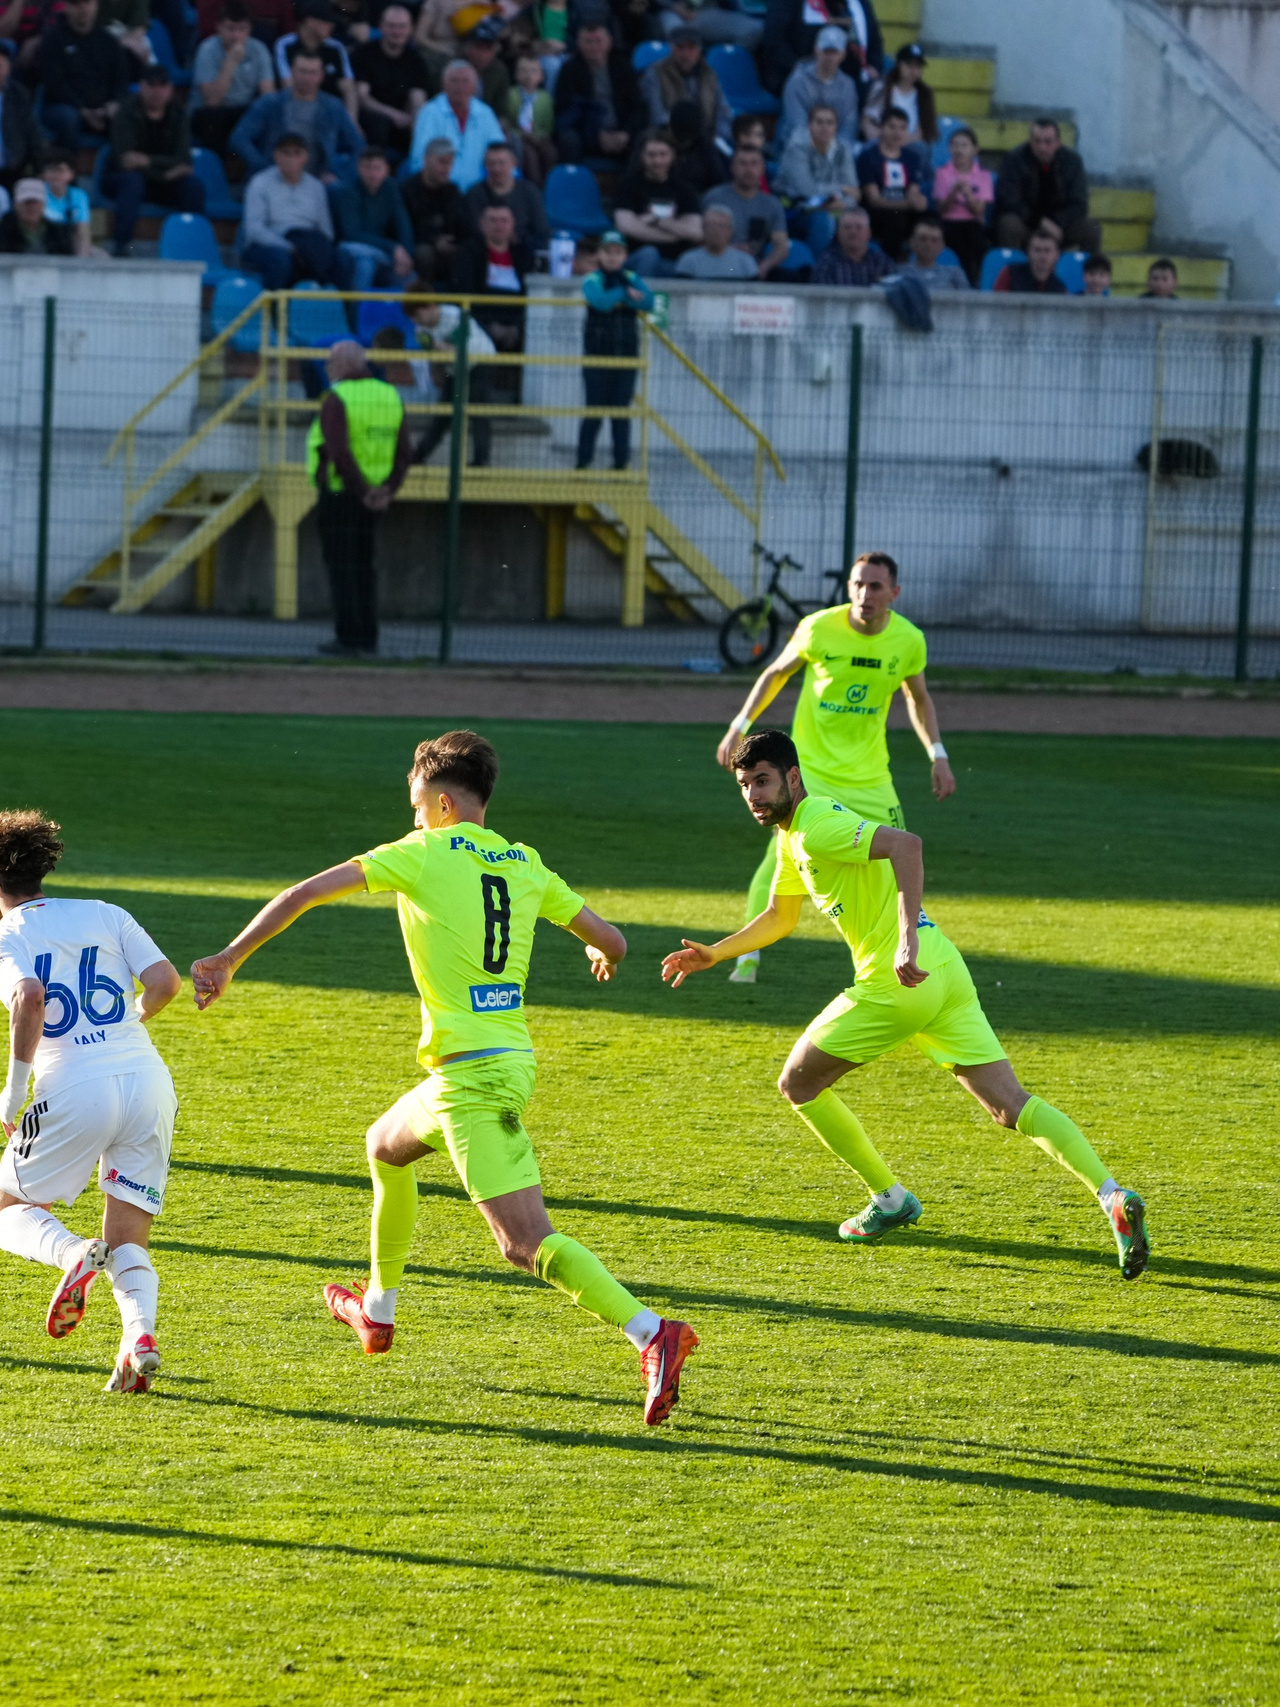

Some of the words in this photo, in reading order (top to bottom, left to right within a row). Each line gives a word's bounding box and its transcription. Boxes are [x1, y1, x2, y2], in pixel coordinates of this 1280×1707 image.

[481, 873, 511, 975] 8
[34, 945, 126, 1039] 66
[117, 1174, 147, 1193] Smart
